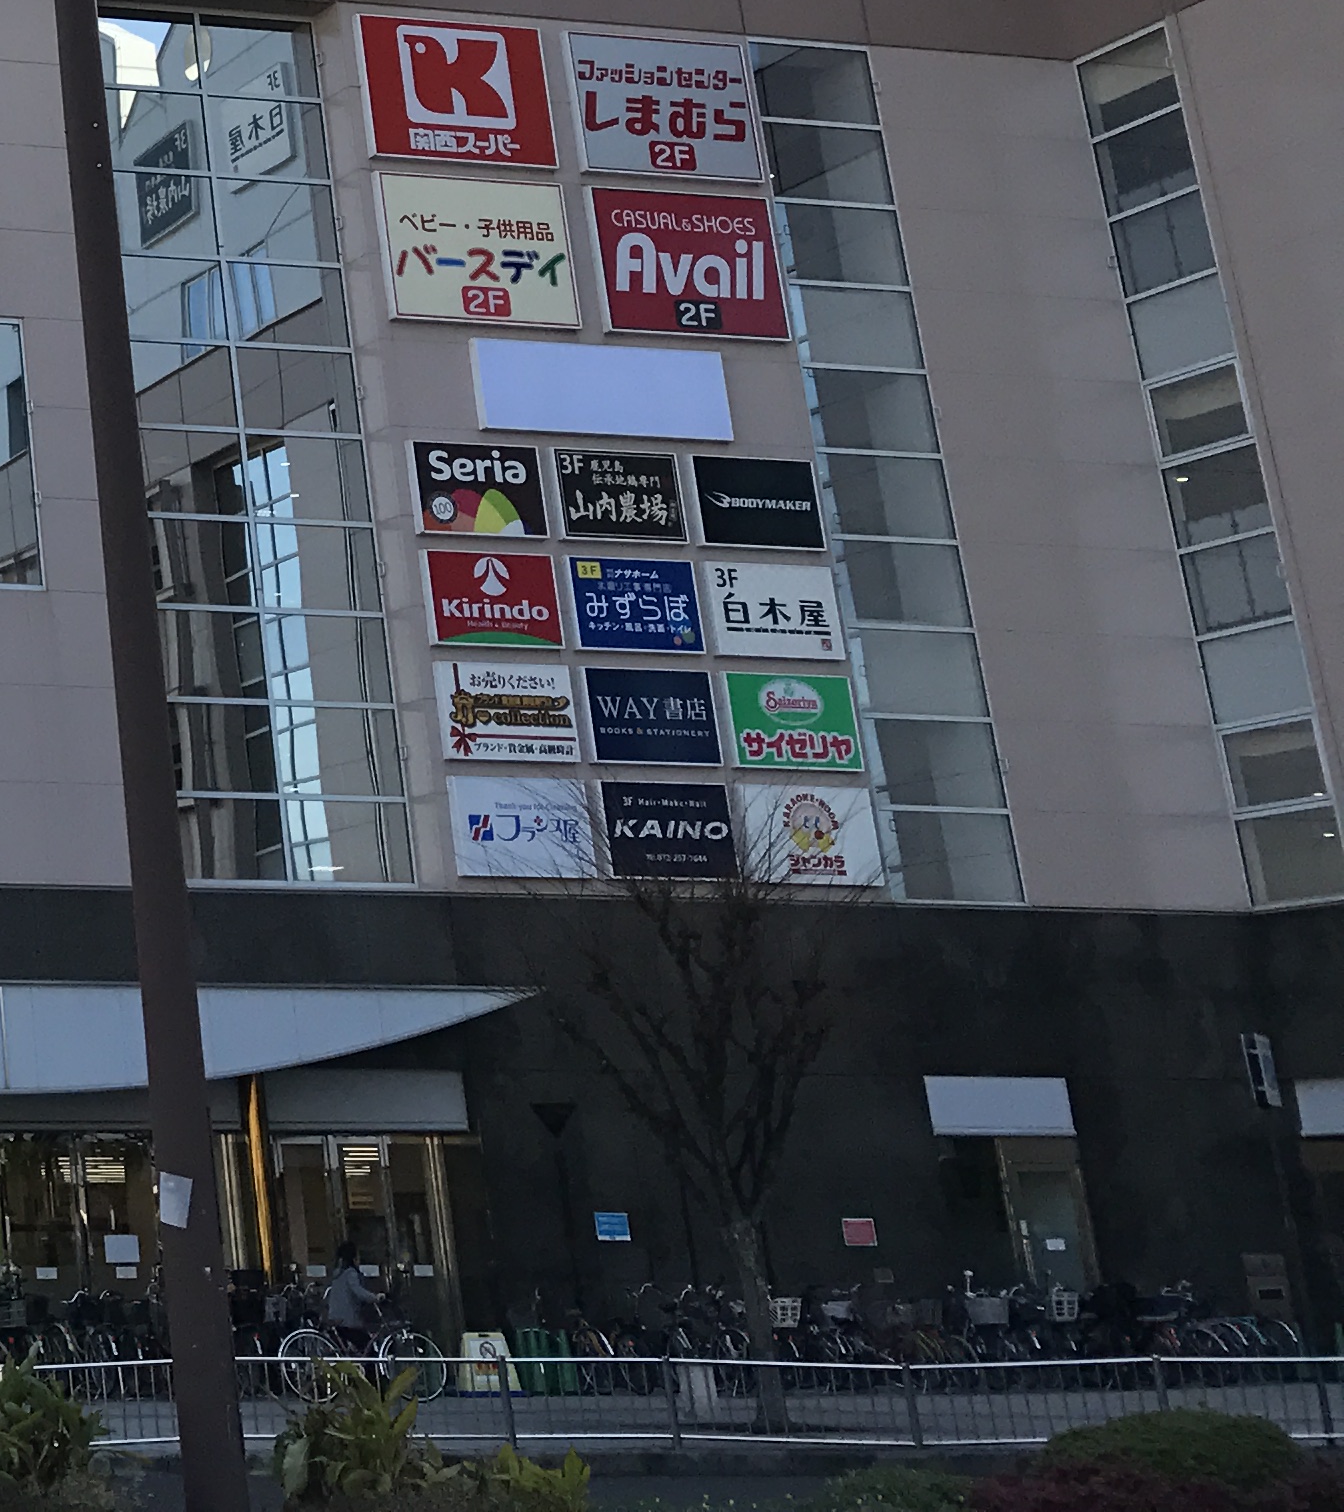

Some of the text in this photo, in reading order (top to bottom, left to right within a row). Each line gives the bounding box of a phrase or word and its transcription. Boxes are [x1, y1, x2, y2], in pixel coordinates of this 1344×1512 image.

[577, 59, 743, 90] ファッションセンター
[584, 91, 746, 143] しまむら
[408, 128, 521, 156] 関西スーパー
[653, 143, 691, 167] 2F
[611, 209, 756, 236] CASUAL&SHOES
[615, 232, 766, 301] Avail
[467, 289, 505, 314] 2F
[678, 302, 717, 328] 2F
[428, 449, 527, 484] Seria
[559, 454, 584, 475] 3F
[568, 489, 668, 526] 山内農場
[731, 496, 812, 511] BODYMAKER
[580, 564, 598, 576] 3F
[714, 567, 739, 588] 3F
[441, 597, 550, 621] Kirindo
[585, 592, 690, 622] みずらぼ
[723, 591, 830, 628] 白木屋
[492, 709, 571, 726] collection
[599, 726, 711, 737] BOOKS & STATIONERY
[742, 731, 853, 761] サイゼリヤ
[622, 796, 633, 806] 3F
[613, 818, 729, 840] KAINO
